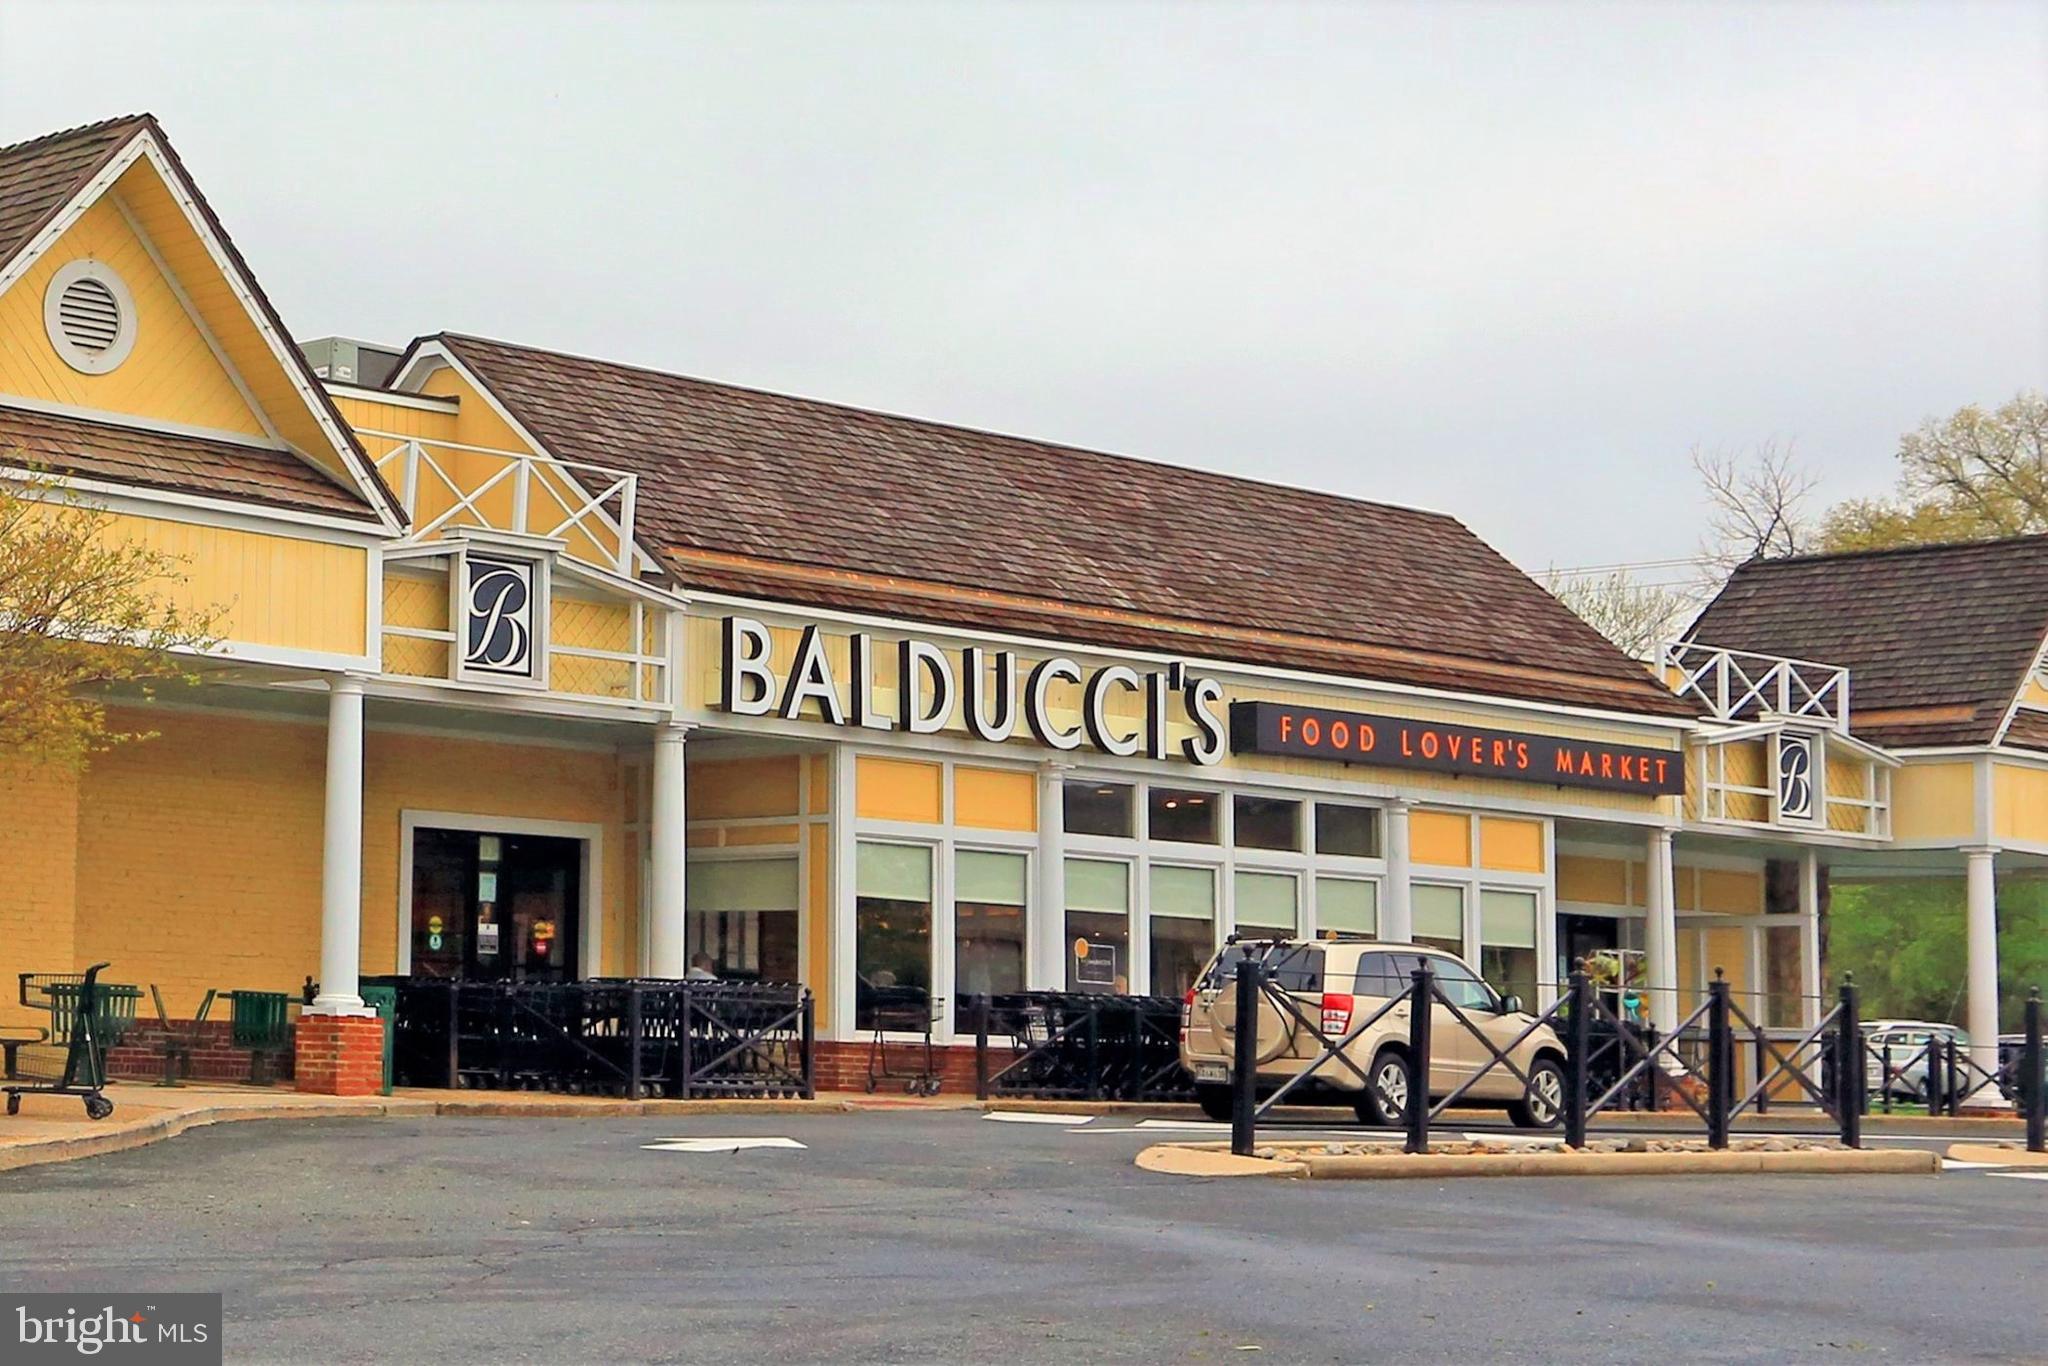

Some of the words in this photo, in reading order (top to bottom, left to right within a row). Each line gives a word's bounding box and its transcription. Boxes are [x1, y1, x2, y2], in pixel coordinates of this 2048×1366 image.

[466, 567, 529, 669] B
[722, 615, 1229, 767] BALDUCCI'S
[1280, 715, 1376, 752] FOOD
[1401, 729, 1529, 769] LOVER'S
[1556, 747, 1669, 785] MARKET
[1779, 741, 1810, 815] B
